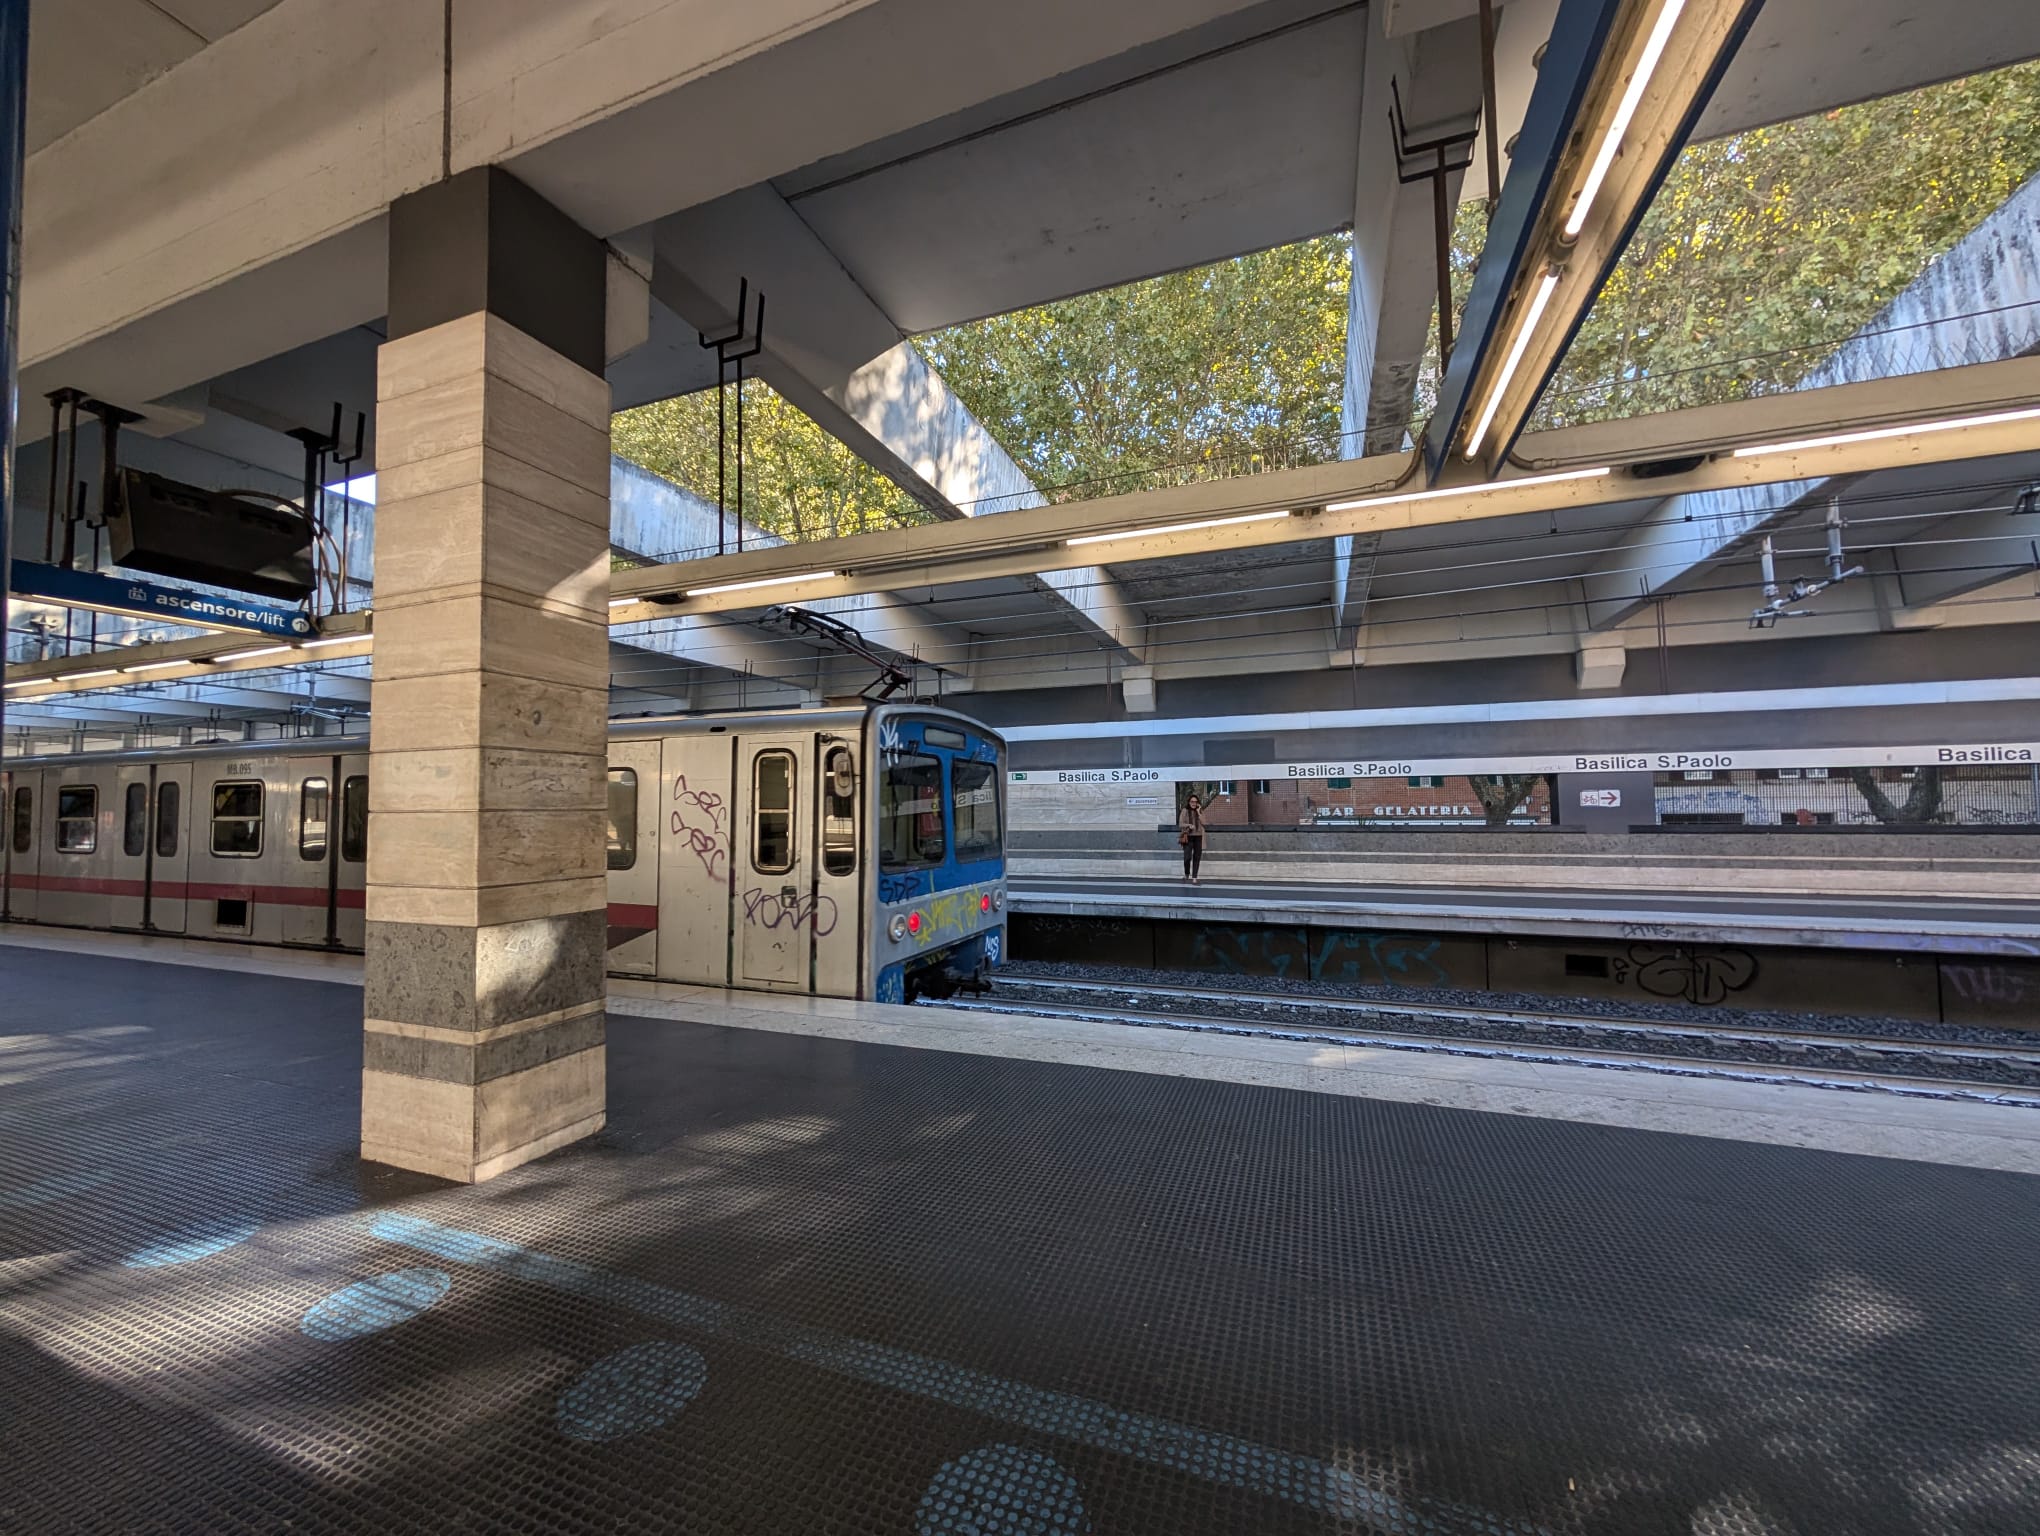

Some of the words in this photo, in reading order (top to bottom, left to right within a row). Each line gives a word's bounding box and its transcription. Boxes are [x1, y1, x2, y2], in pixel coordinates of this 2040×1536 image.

[156, 593, 285, 628] ascensore/lift
[1938, 746, 2032, 762] Basilica
[1288, 765, 1345, 777] Basilica
[1353, 762, 1412, 775] S.Paolo
[1575, 756, 1648, 770] Basilica
[1657, 754, 1732, 768] S.Paolo
[1058, 772, 1105, 782] Basilica
[1111, 770, 1159, 781] S.Paolo
[1321, 807, 1354, 817] BAR
[1373, 805, 1472, 816] GELATERIA
